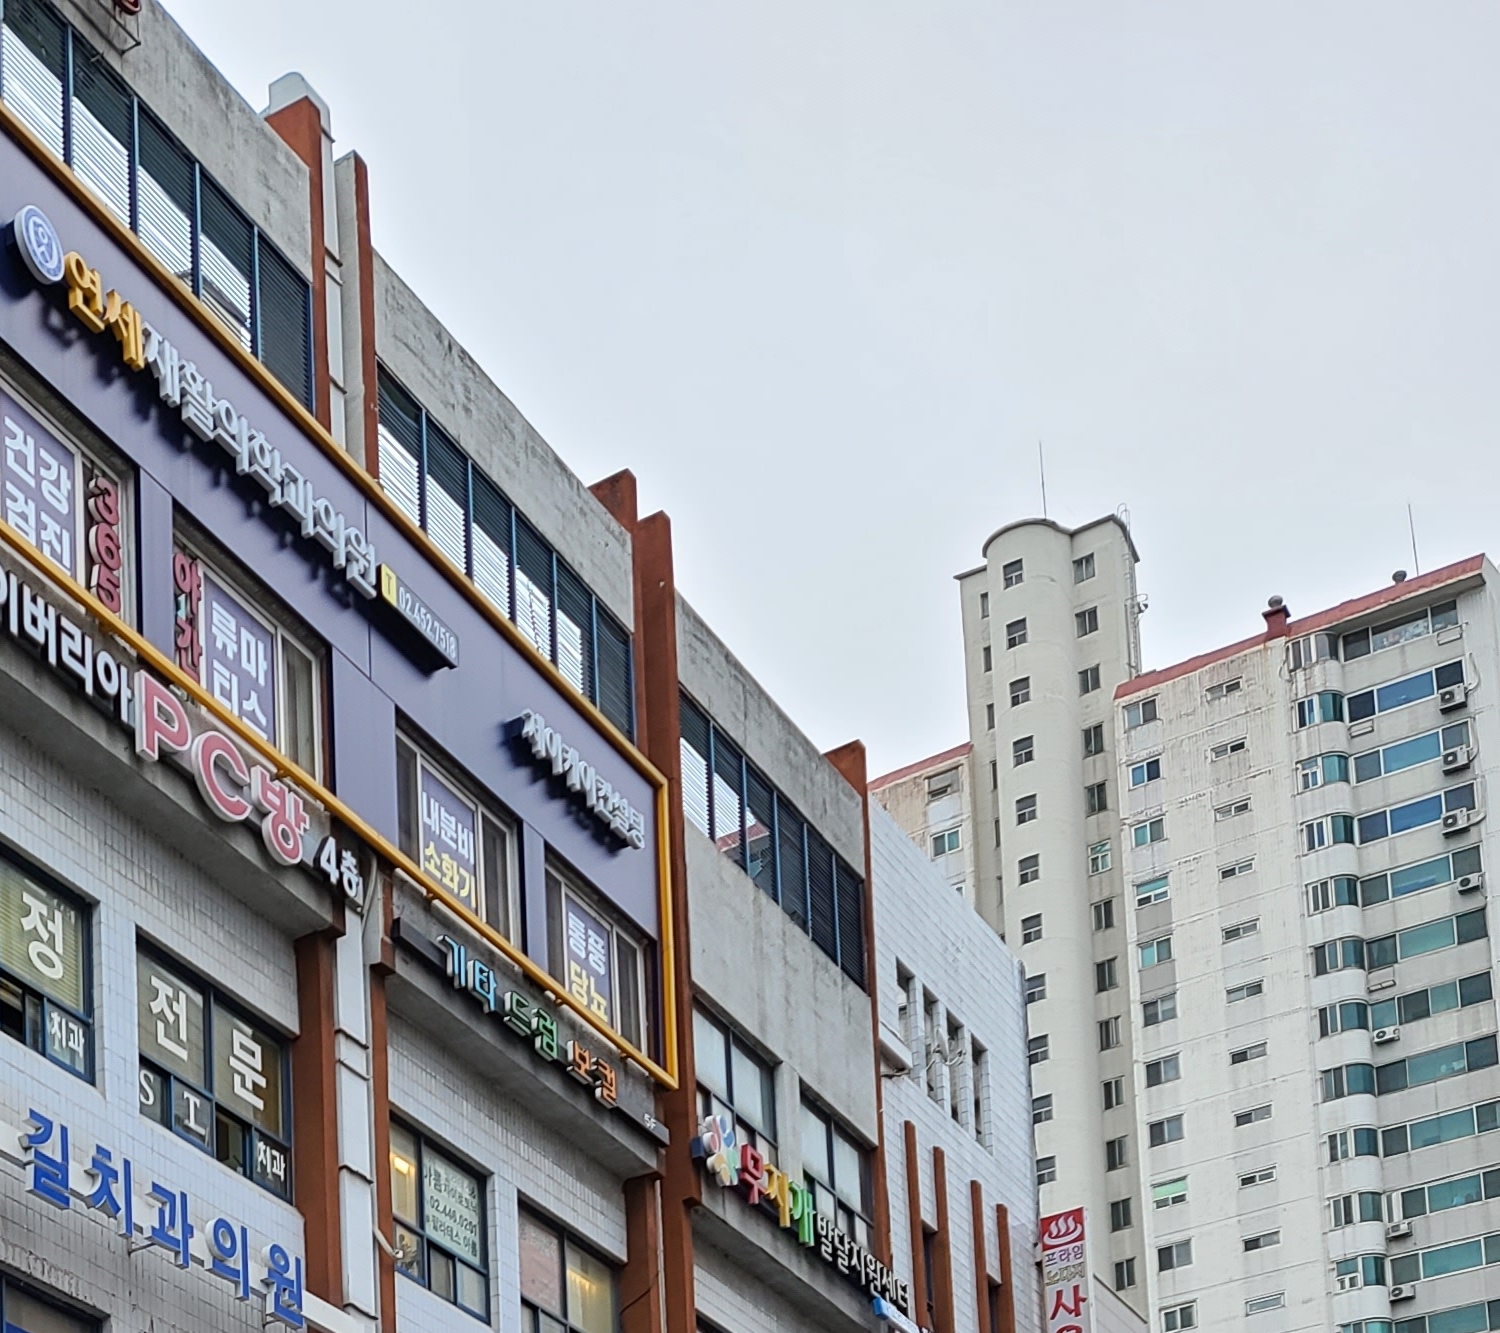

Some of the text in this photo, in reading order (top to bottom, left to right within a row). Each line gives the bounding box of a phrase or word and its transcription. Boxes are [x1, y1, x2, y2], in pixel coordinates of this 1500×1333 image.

[4, 416, 72, 515] 건강
[90, 475, 122, 615] 365
[136, 670, 311, 866] PC방
[421, 791, 475, 867] 내분비
[424, 844, 477, 912] 소화기
[567, 910, 608, 978] 통풍
[569, 959, 610, 1026] 당뇨
[437, 934, 498, 1014] 기타
[503, 990, 559, 1063] 드럼
[22, 1107, 305, 1331] 길치과의원
[739, 1142, 816, 1248] 무지개
